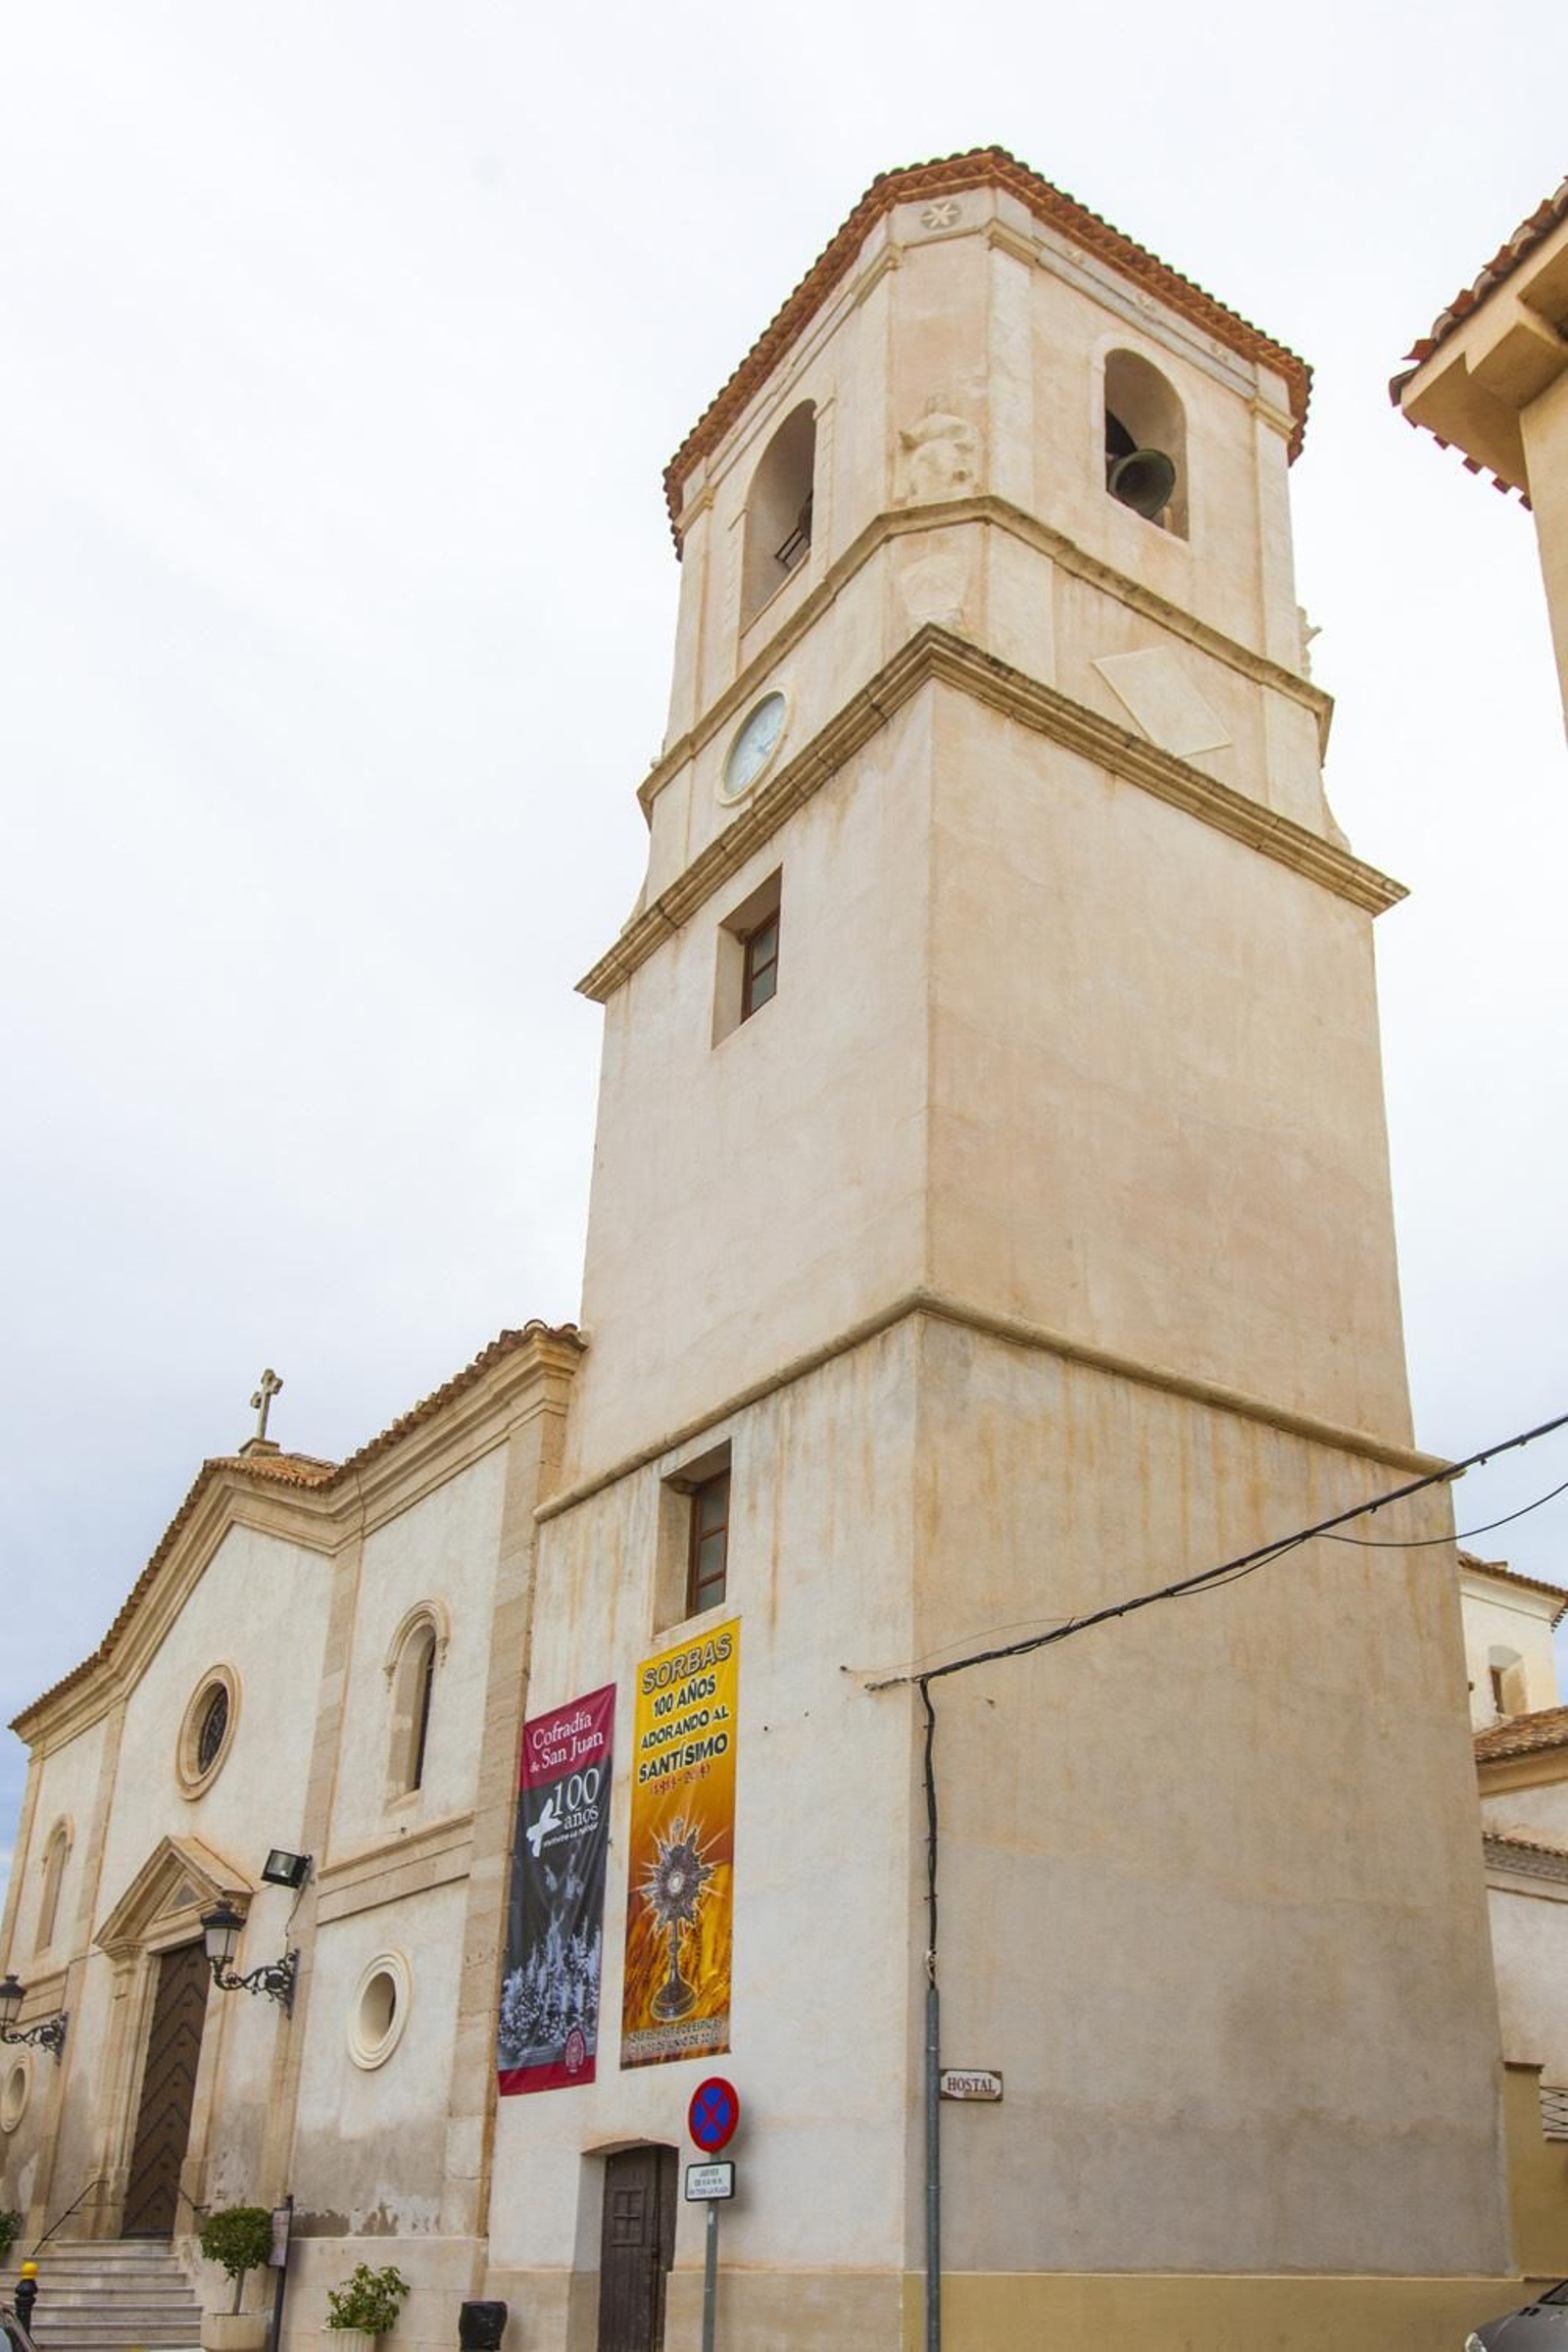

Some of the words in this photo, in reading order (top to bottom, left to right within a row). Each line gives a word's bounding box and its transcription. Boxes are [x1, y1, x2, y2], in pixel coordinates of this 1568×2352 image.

[642, 1633, 732, 1695] SORBAS
[654, 1691, 673, 1718] 100
[676, 1674, 715, 1708] AÑOS
[532, 1711, 592, 1749] Cofradía
[641, 1709, 710, 1748] ADORANDO
[711, 1705, 729, 1721] AL
[542, 1747, 566, 1769] San
[570, 1732, 604, 1762] Juan
[639, 1733, 728, 1784] SANTÍSIMO
[553, 1768, 599, 1816] 100
[564, 1805, 599, 1831] años
[948, 2077, 996, 2092] HOSTAL
